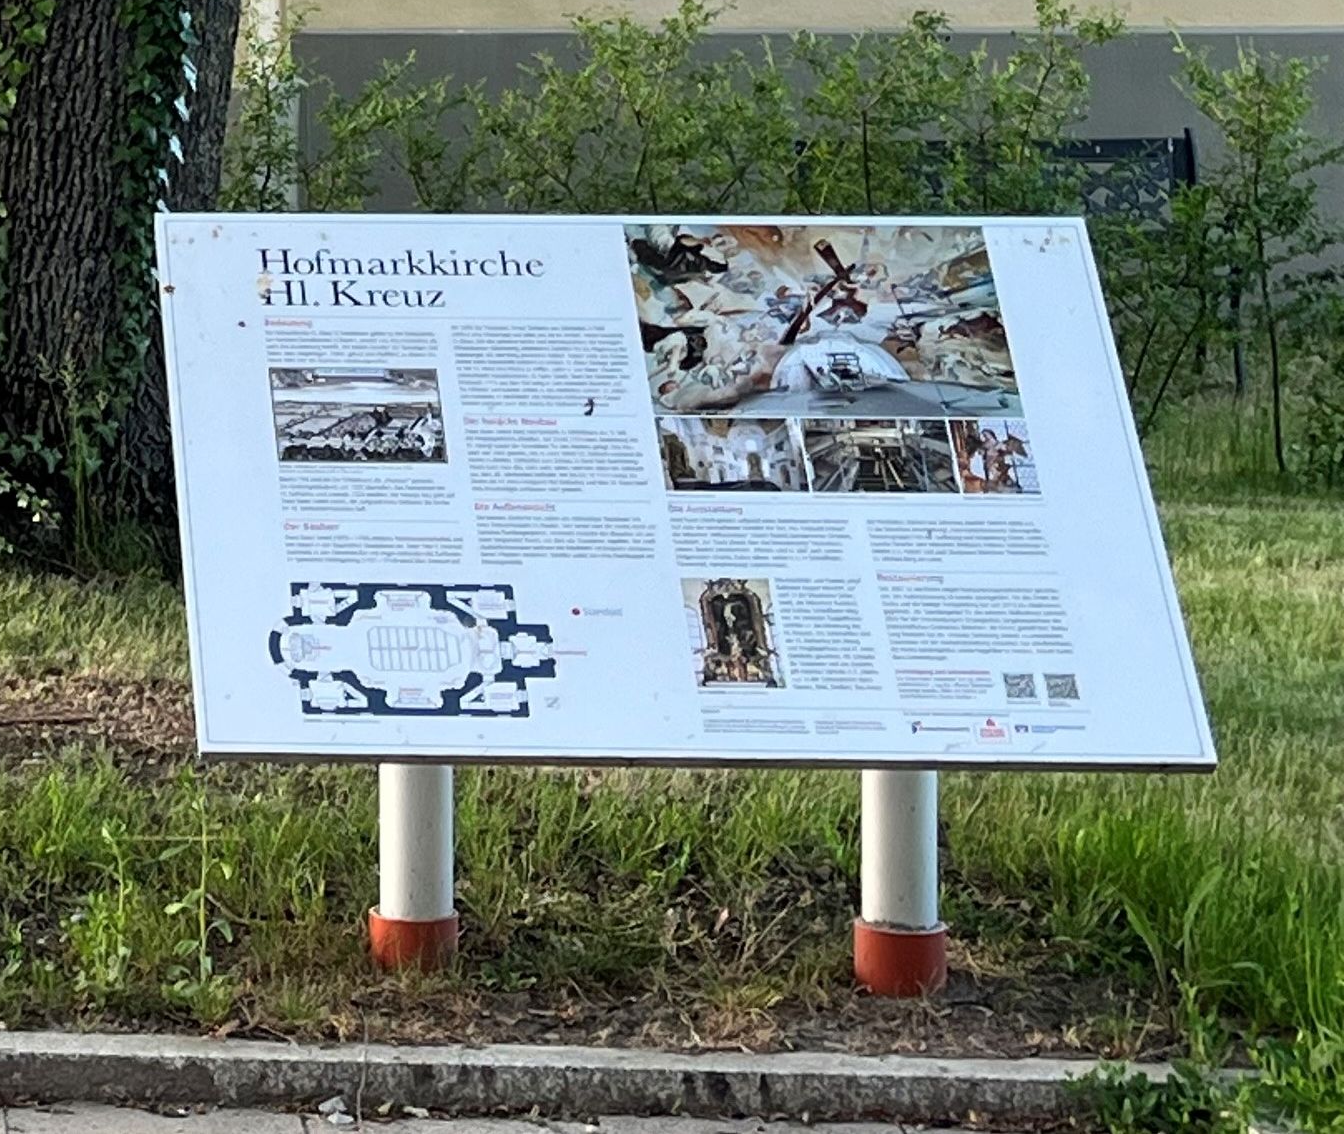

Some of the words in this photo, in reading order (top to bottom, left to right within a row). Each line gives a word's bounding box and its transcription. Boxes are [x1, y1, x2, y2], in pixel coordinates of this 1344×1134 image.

[256, 248, 545, 277] Hofmarkkirche
[262, 279, 321, 308] Hl.
[330, 279, 446, 308] Kreuz
